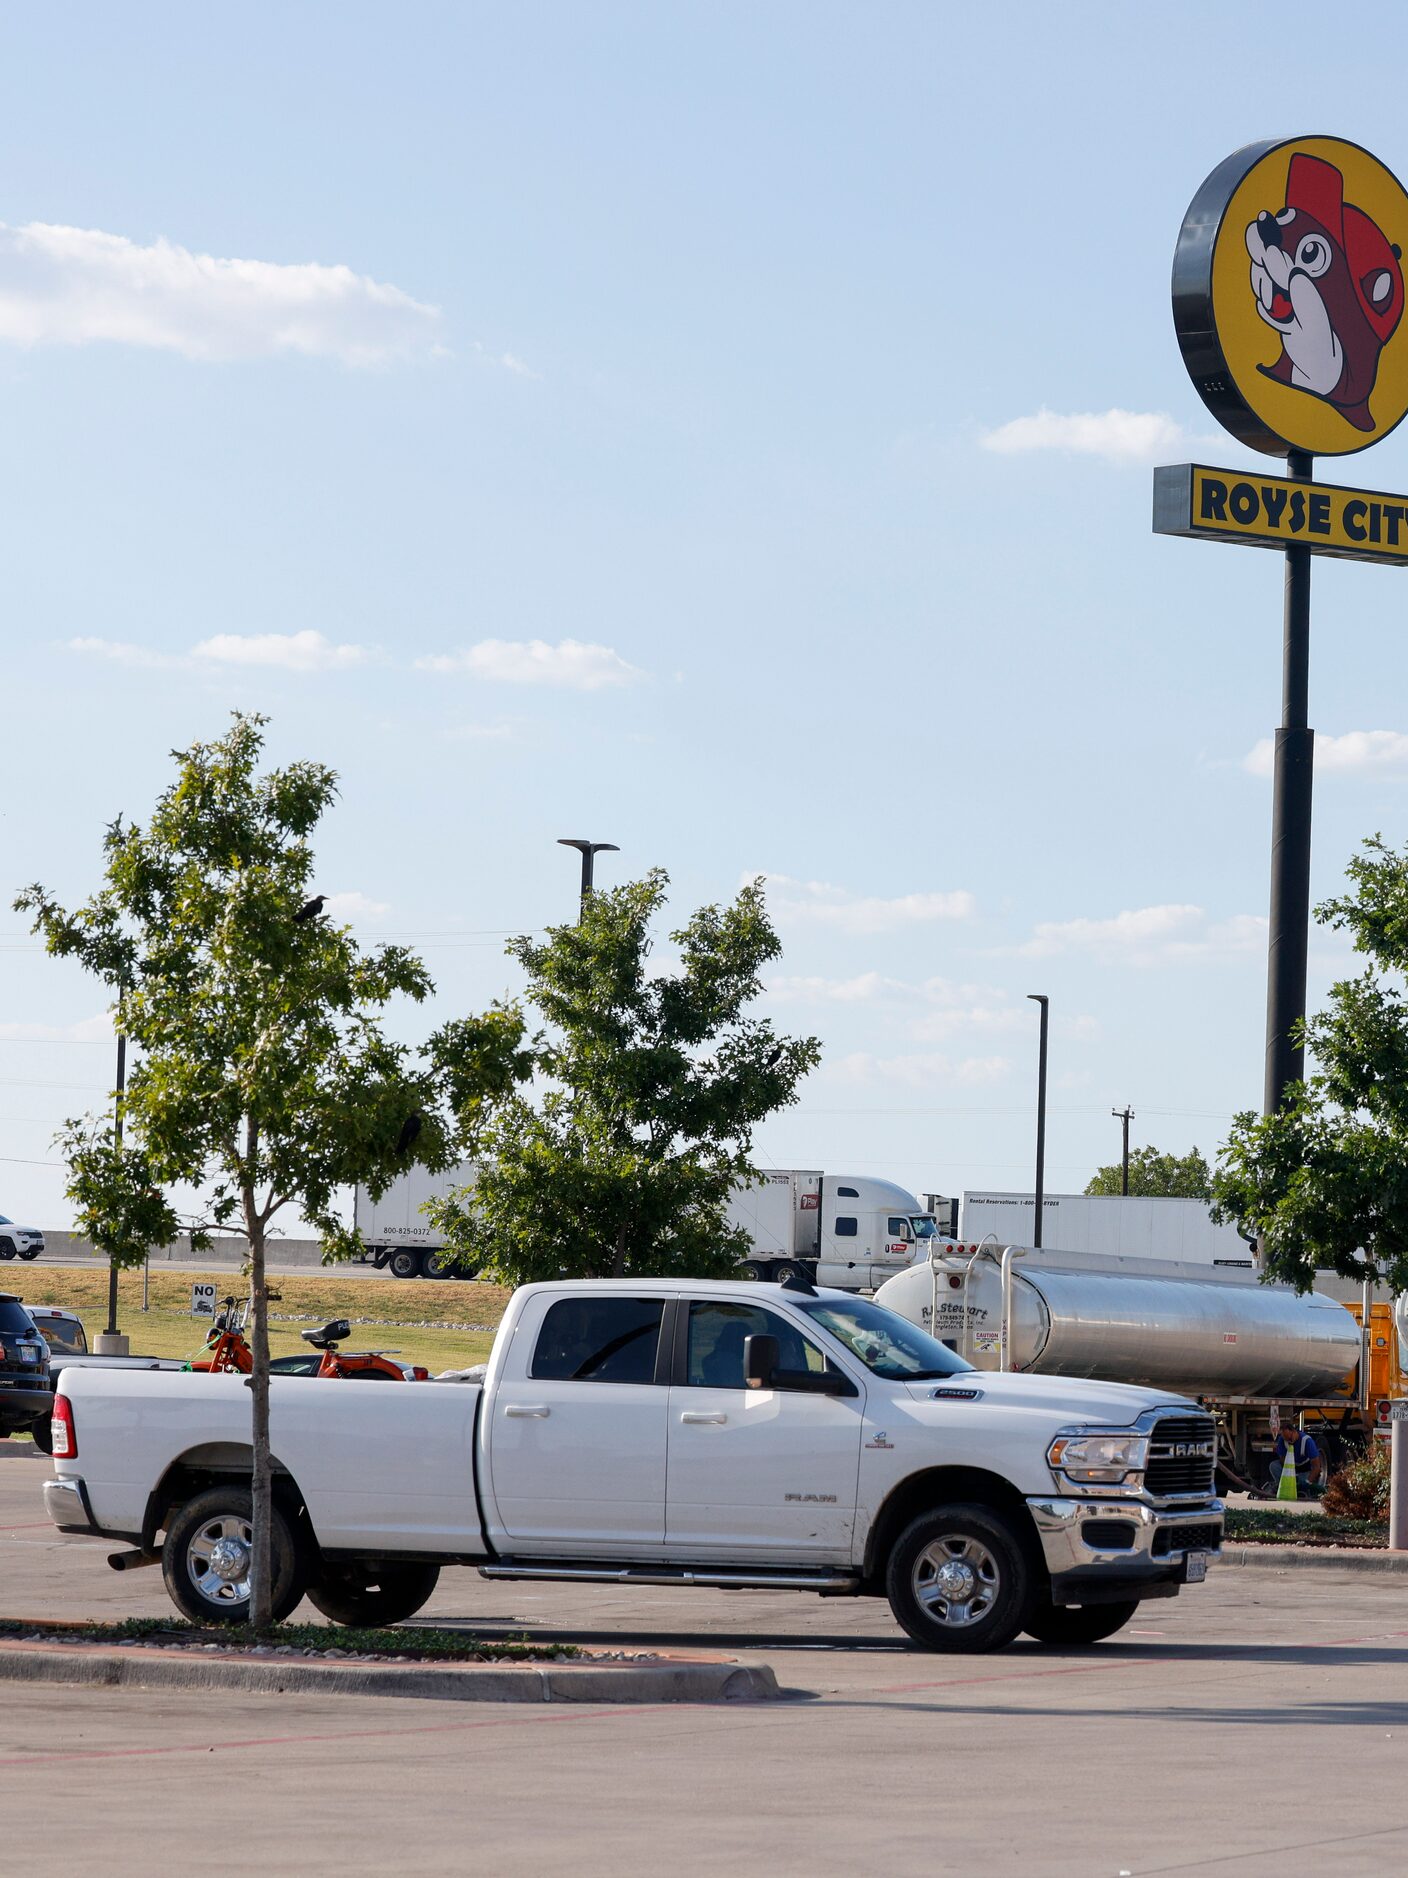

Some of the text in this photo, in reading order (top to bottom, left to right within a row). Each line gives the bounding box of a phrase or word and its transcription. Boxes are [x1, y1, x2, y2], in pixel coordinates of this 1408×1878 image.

[1200, 478, 1331, 536] ROYSE
[383, 1226, 431, 1236] 800-825-0372
[194, 1285, 214, 1297] NO
[1175, 1443, 1208, 1456] RAM
[784, 1493, 837, 1503] RAM
